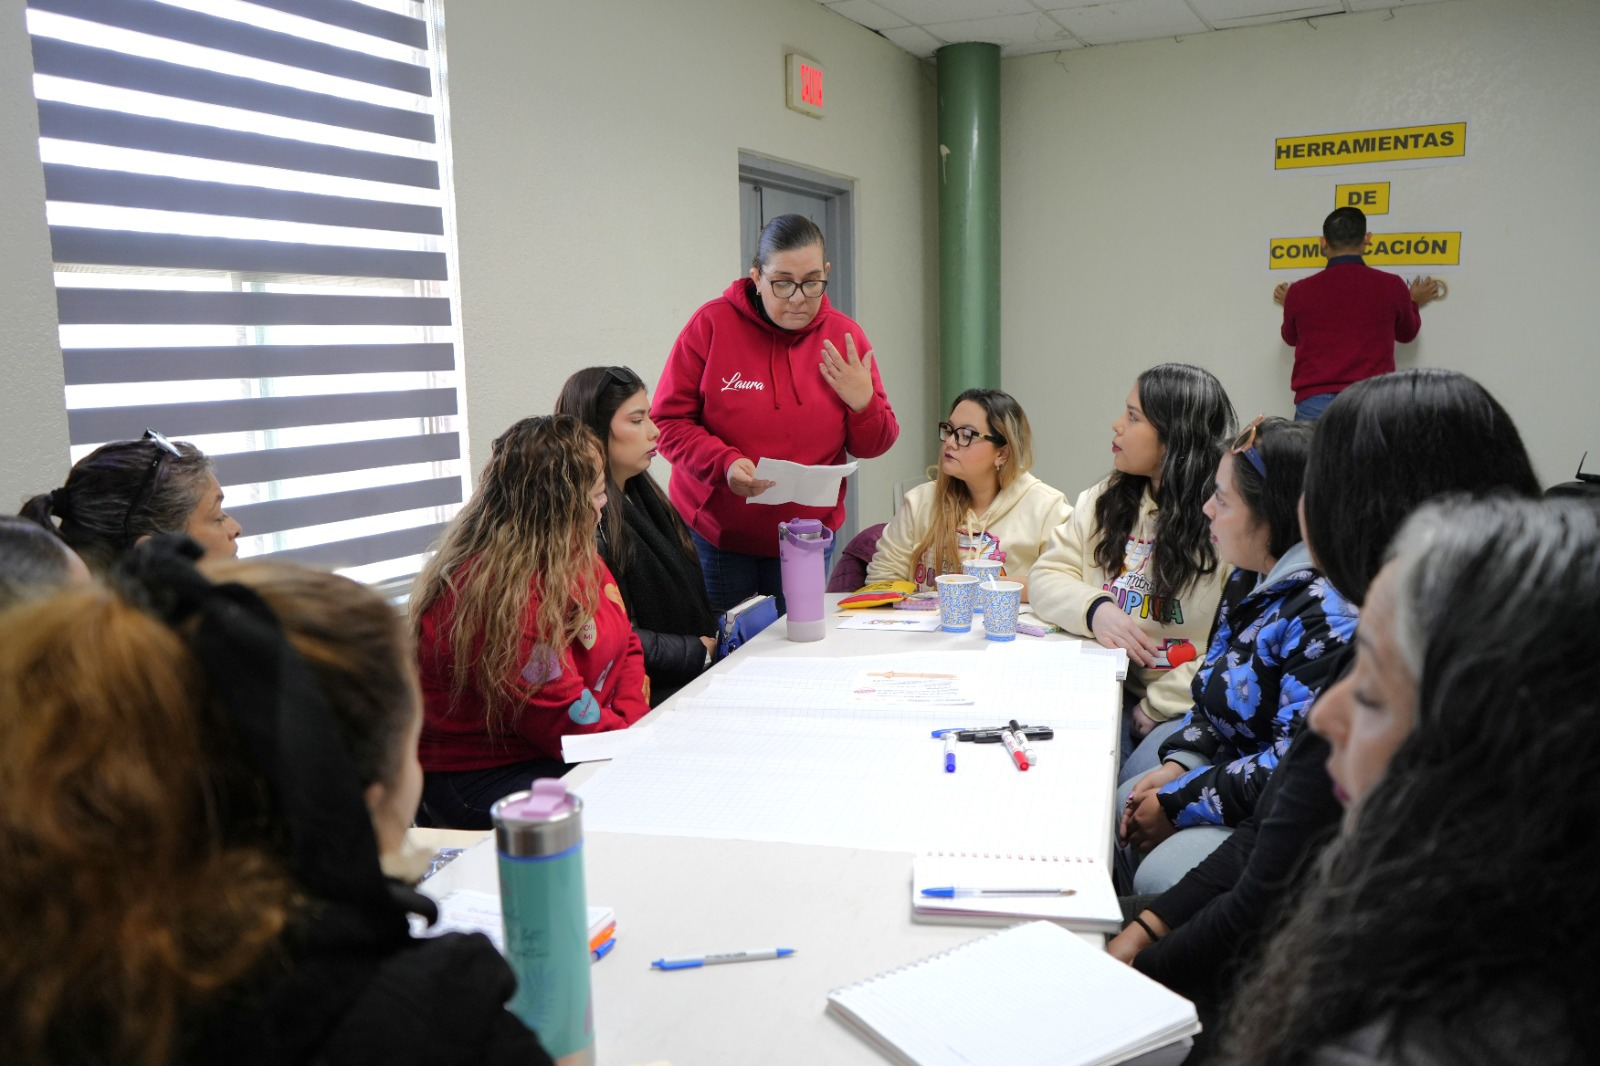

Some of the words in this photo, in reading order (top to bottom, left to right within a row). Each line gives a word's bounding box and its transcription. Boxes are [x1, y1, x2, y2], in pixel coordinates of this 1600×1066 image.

[1276, 130, 1455, 159] HERRAMIENTAS
[1347, 190, 1377, 206] DE
[1271, 236, 1448, 259] COMCACIÓN
[720, 371, 765, 392] Laura
[1103, 583, 1185, 625] UPITA
